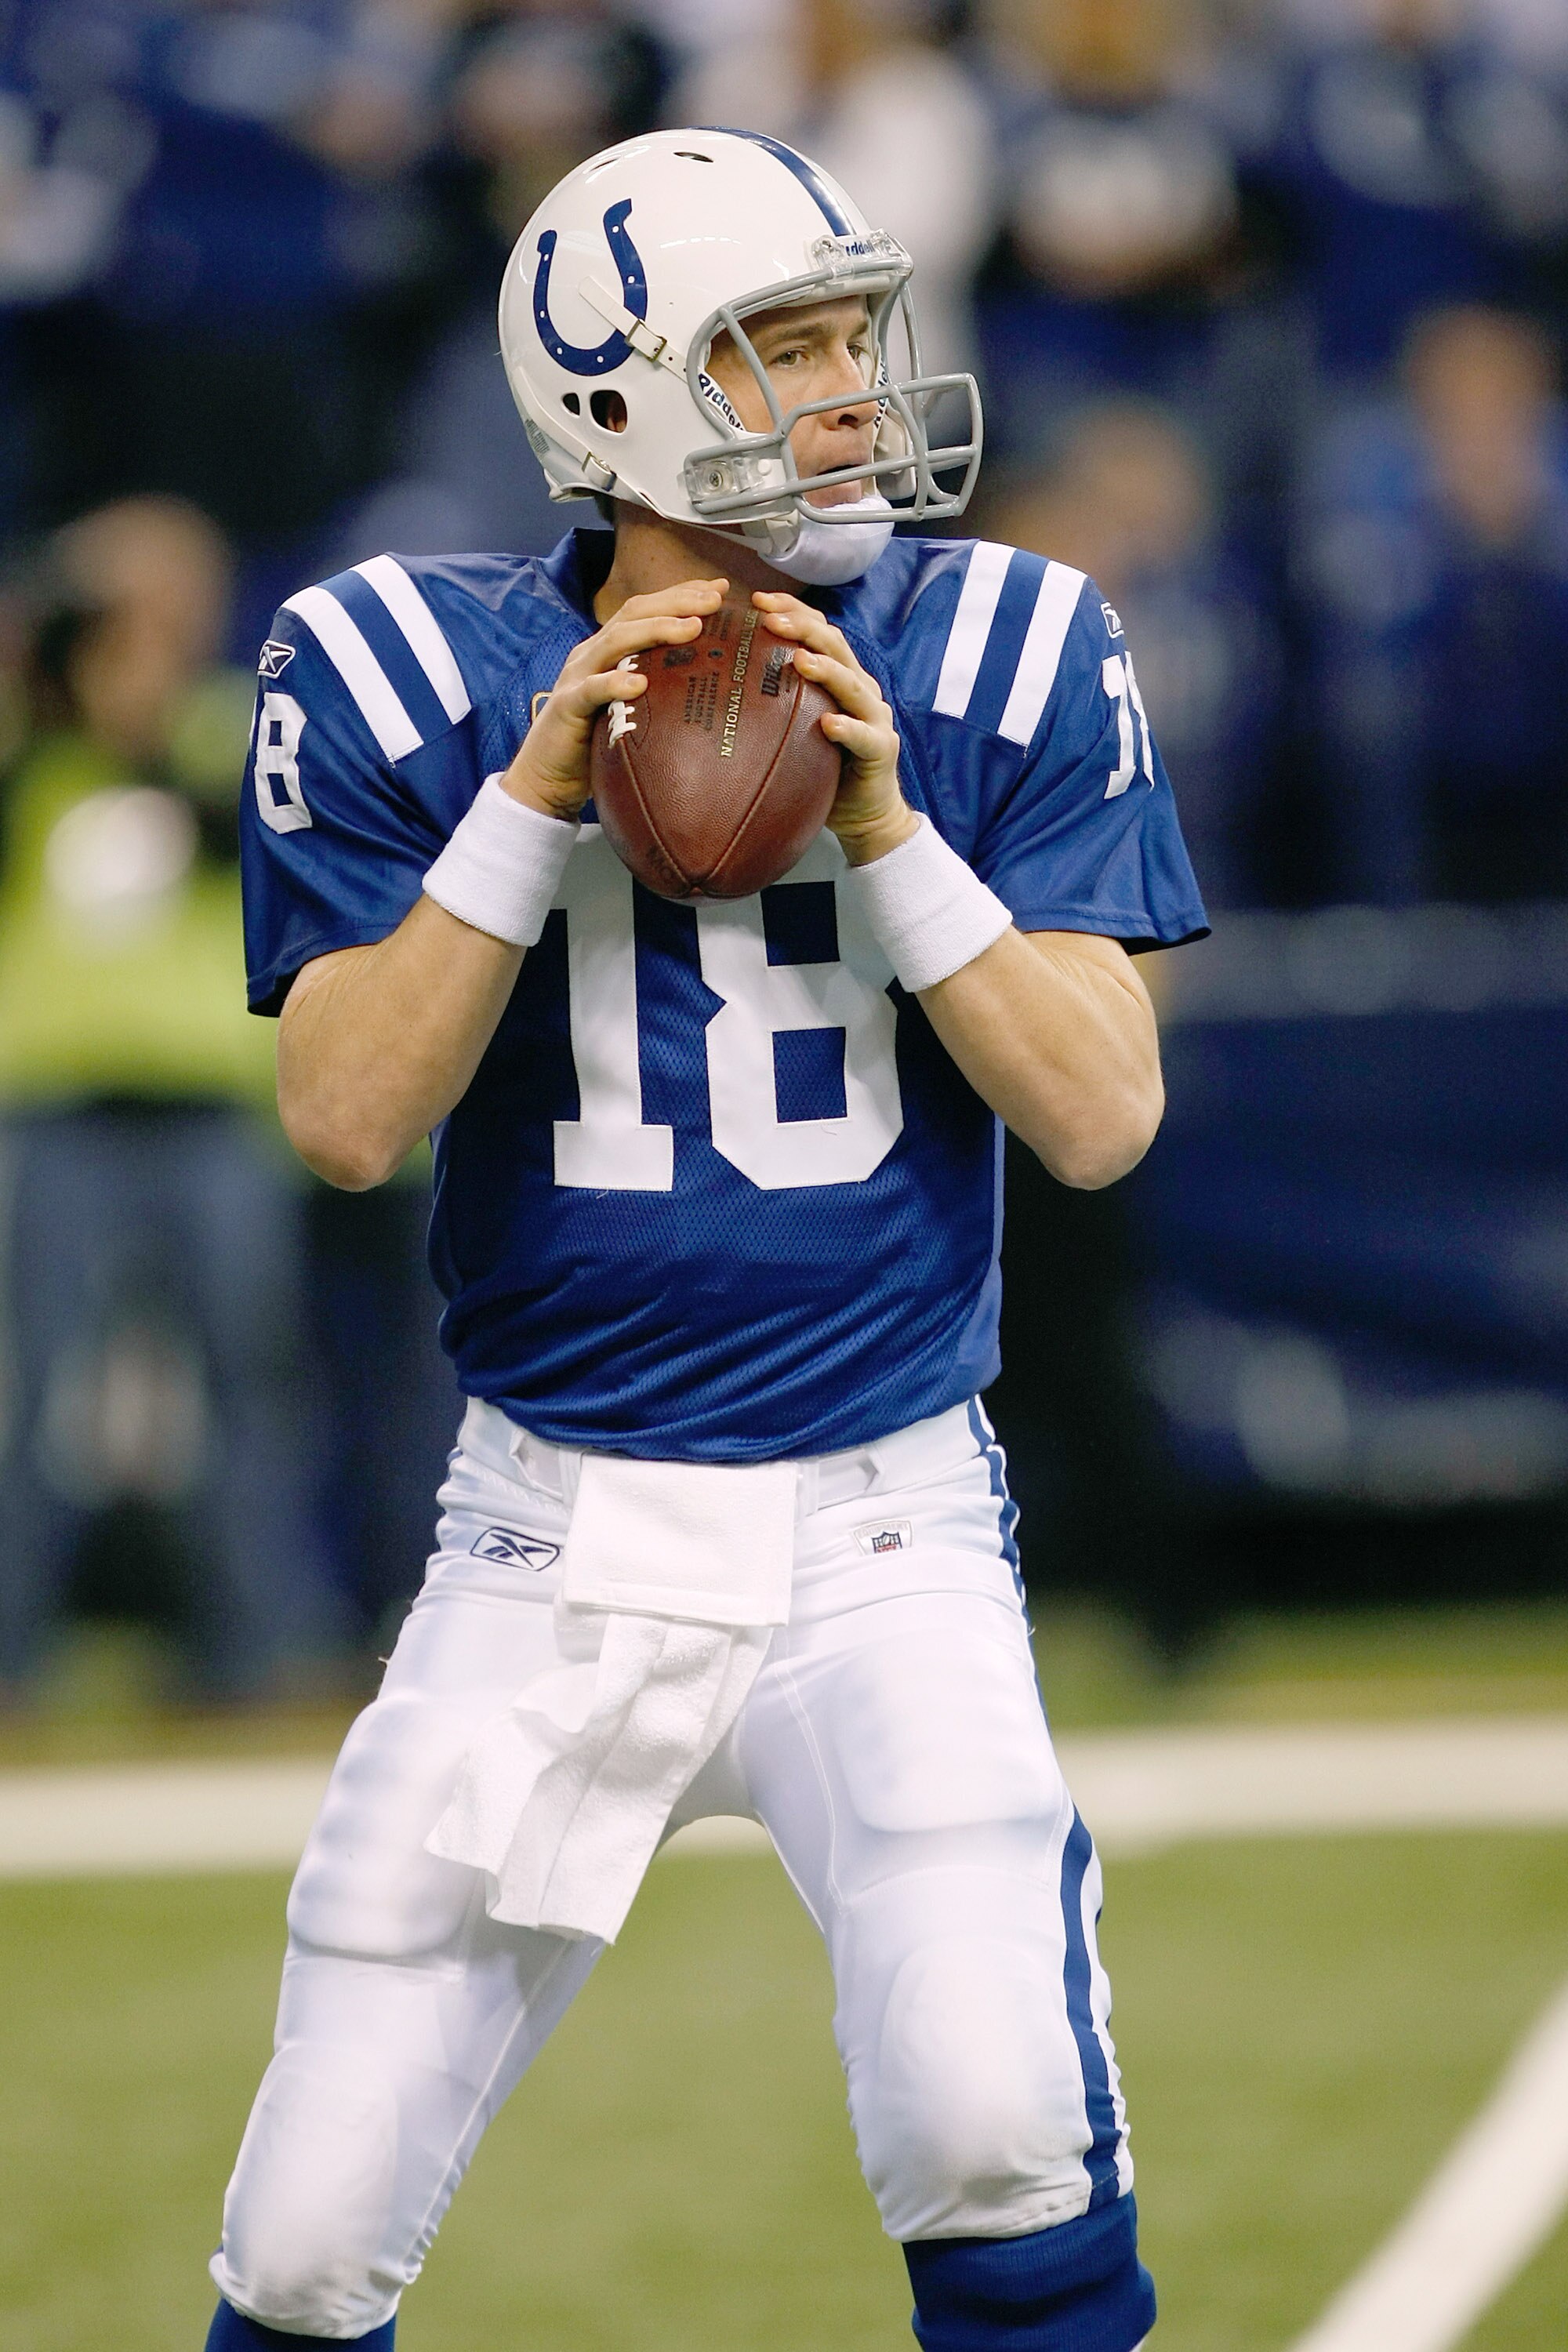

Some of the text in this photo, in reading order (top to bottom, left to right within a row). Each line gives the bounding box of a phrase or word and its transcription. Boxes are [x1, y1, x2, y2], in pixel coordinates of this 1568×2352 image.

[844, 239, 876, 256] iddell
[698, 373, 743, 430] Ridde
[720, 688, 742, 757] NATIONAL
[733, 630, 753, 683] FOOTBALL
[249, 691, 313, 834] 8
[550, 822, 905, 1191] 18
